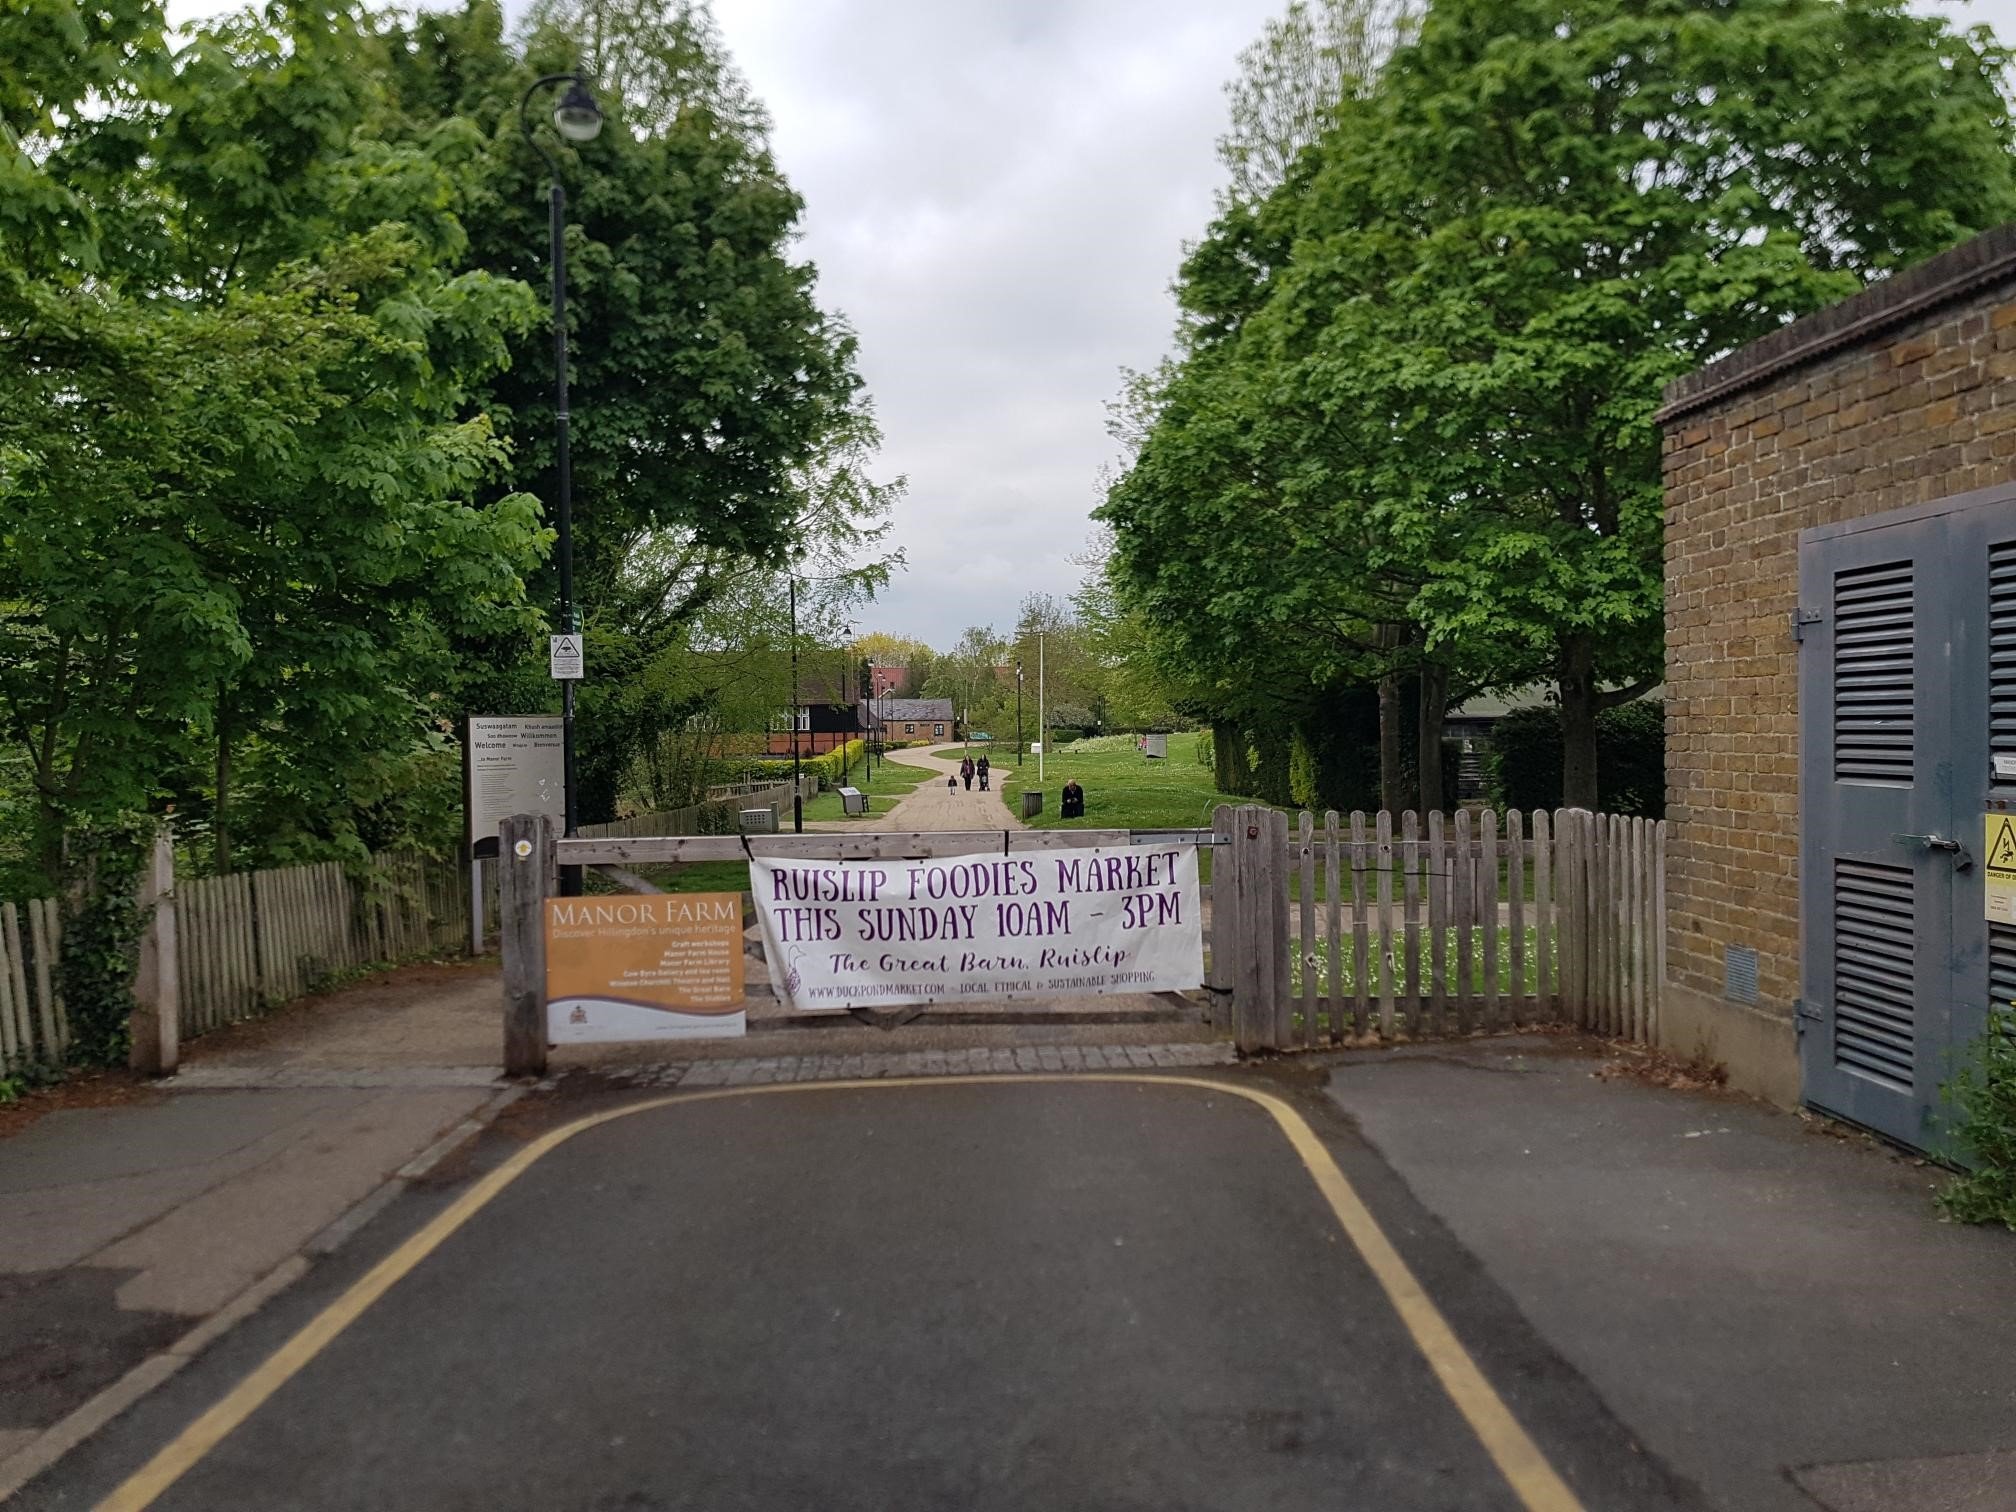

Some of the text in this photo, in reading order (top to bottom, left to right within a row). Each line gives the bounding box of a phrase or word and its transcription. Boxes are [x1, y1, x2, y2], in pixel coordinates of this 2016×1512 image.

[474, 741, 506, 749] Welcome
[770, 851, 1180, 902] RUISLIP FOODIES MARKET
[1987, 871, 2005, 879] DANGER
[552, 901, 735, 926] MANOR FARM
[774, 907, 841, 942] THIS
[858, 903, 978, 941] SUNDAY
[997, 900, 1072, 937] 10AM
[1121, 891, 1182, 930] 3PM
[553, 928, 595, 938] Discover
[659, 926, 692, 937] unique
[695, 924, 736, 936] heritage
[660, 959, 682, 967] Manor
[704, 958, 730, 966] Library
[829, 953, 870, 974] The
[879, 952, 950, 973] Great
[1040, 946, 1131, 968] Ruislip
[960, 982, 989, 994] LOCAL
[994, 980, 1032, 994] ETHICAL
[1048, 974, 1105, 990] SUSTAINABLE
[1110, 971, 1155, 986] SHOPPING
